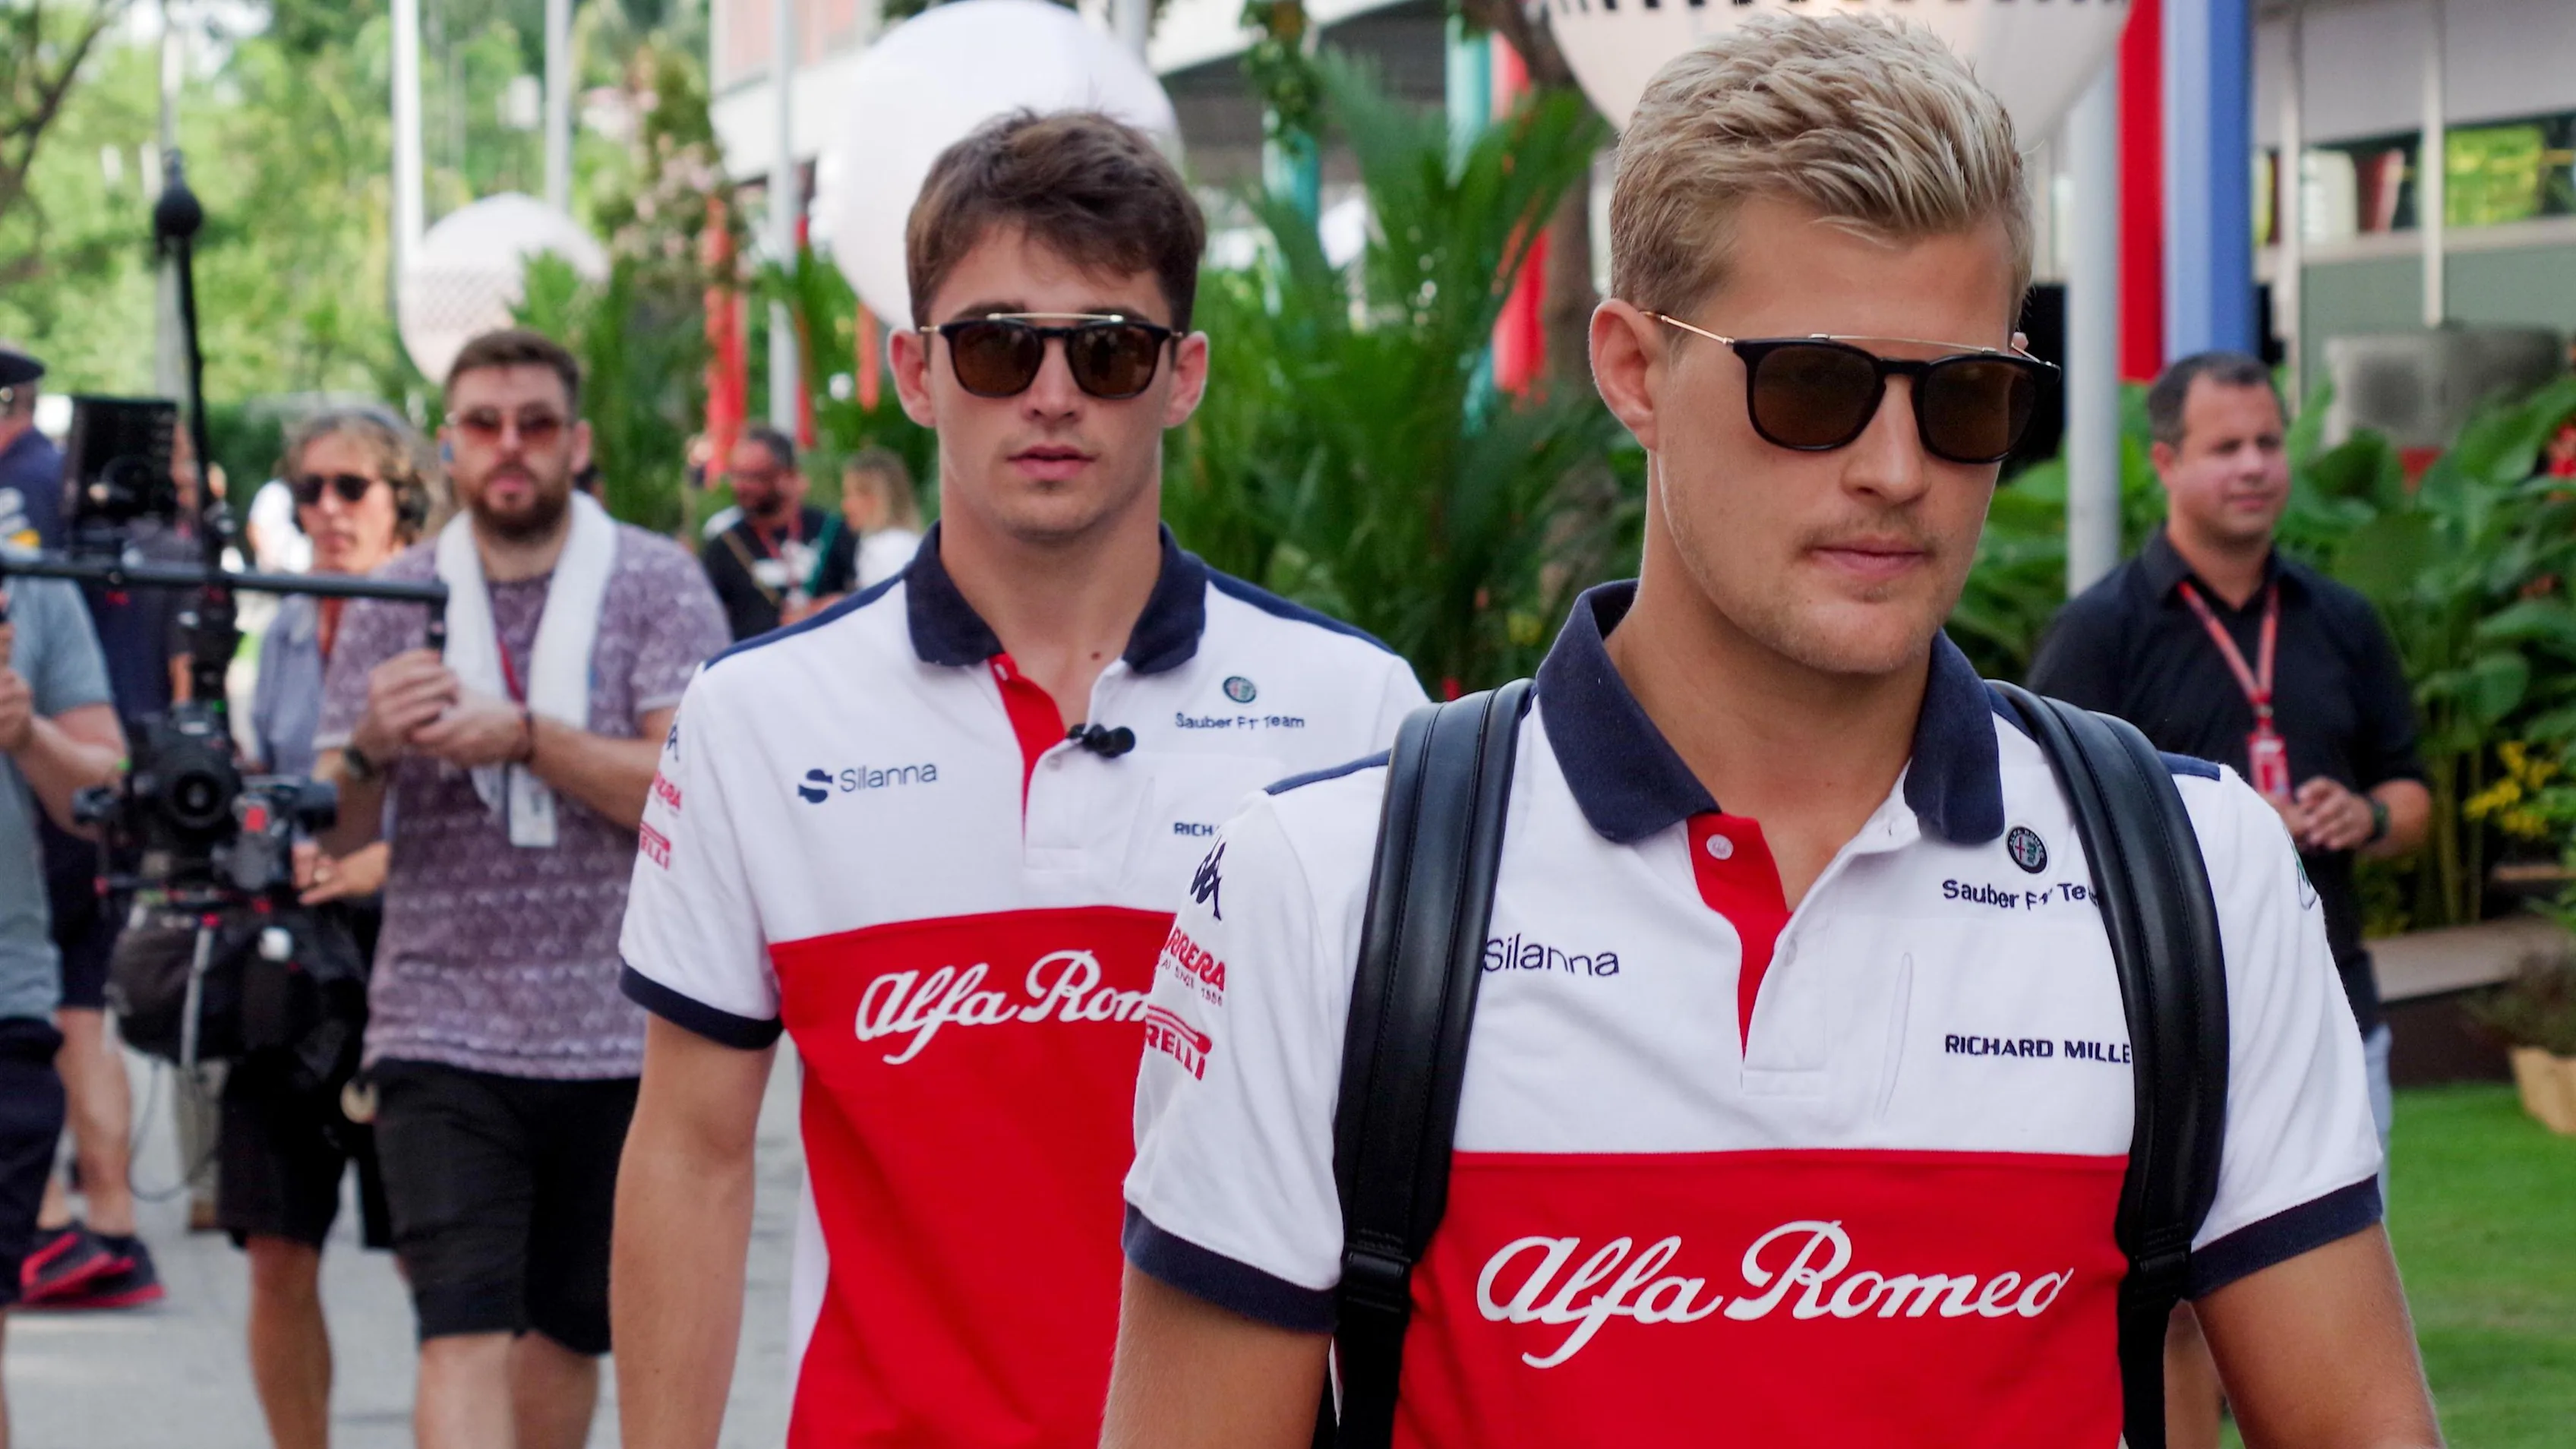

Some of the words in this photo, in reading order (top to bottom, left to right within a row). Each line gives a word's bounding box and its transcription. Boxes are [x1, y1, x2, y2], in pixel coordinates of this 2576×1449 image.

[1176, 712, 1233, 729] Sauber
[1264, 714, 1305, 729] Team
[840, 763, 938, 793] Silanna
[1173, 822, 1214, 837] RICH
[1942, 879, 2020, 909] Sauber
[1483, 933, 1621, 977] Silanna
[855, 962, 1020, 1065] Alfa
[1944, 1034, 2054, 1058] RICHARD
[2064, 1040, 2132, 1065] MILLE
[1476, 1235, 1724, 1369] Alfa
[1723, 1220, 2075, 1322] Romeo
